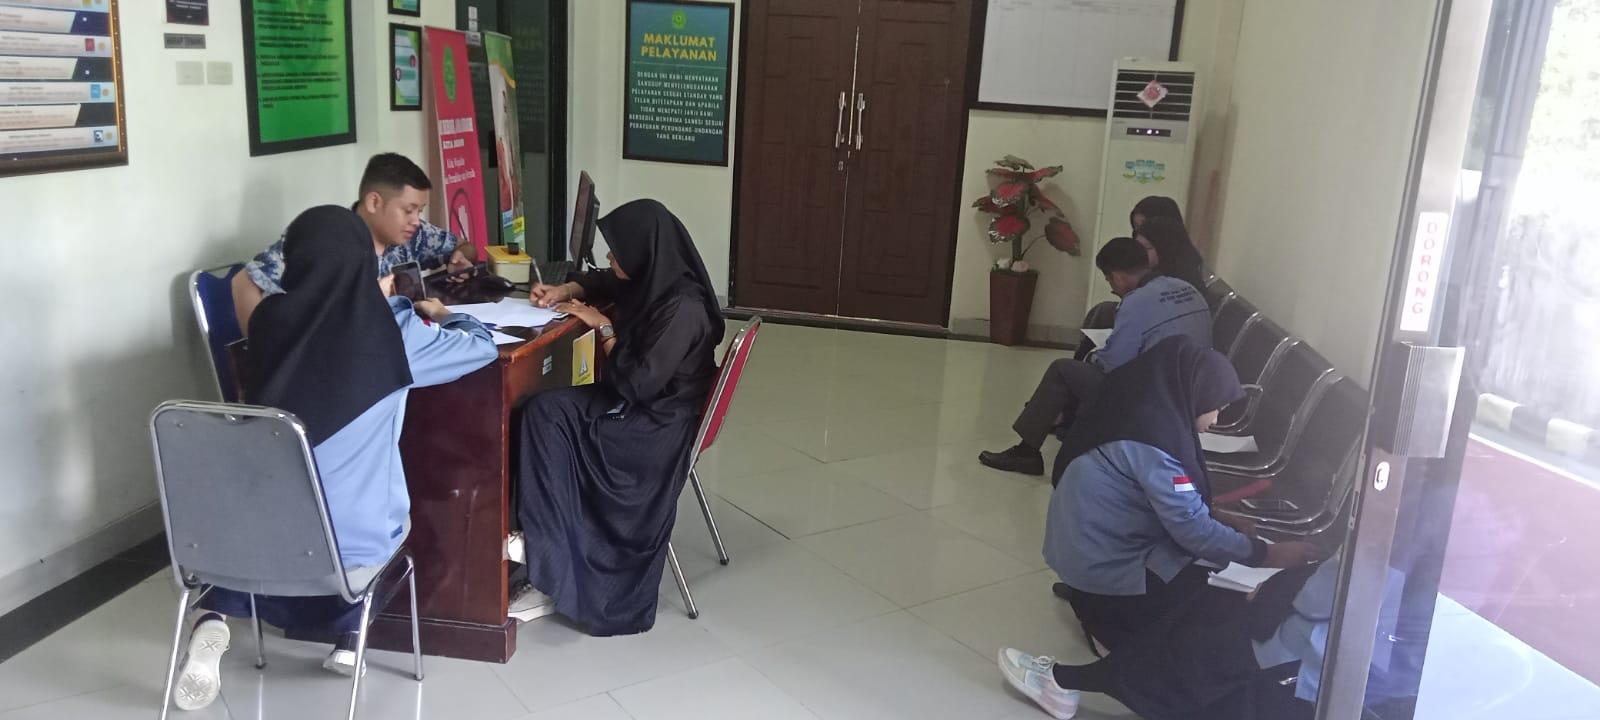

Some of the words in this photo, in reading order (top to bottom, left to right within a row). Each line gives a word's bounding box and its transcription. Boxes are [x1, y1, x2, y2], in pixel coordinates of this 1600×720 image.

[643, 33, 716, 48] MAKLUMAT
[641, 46, 717, 61] PELAYANAN
[684, 74, 719, 82] MENYATAKAN
[698, 101, 720, 109] APABILA
[1412, 222, 1438, 314] DORONG
